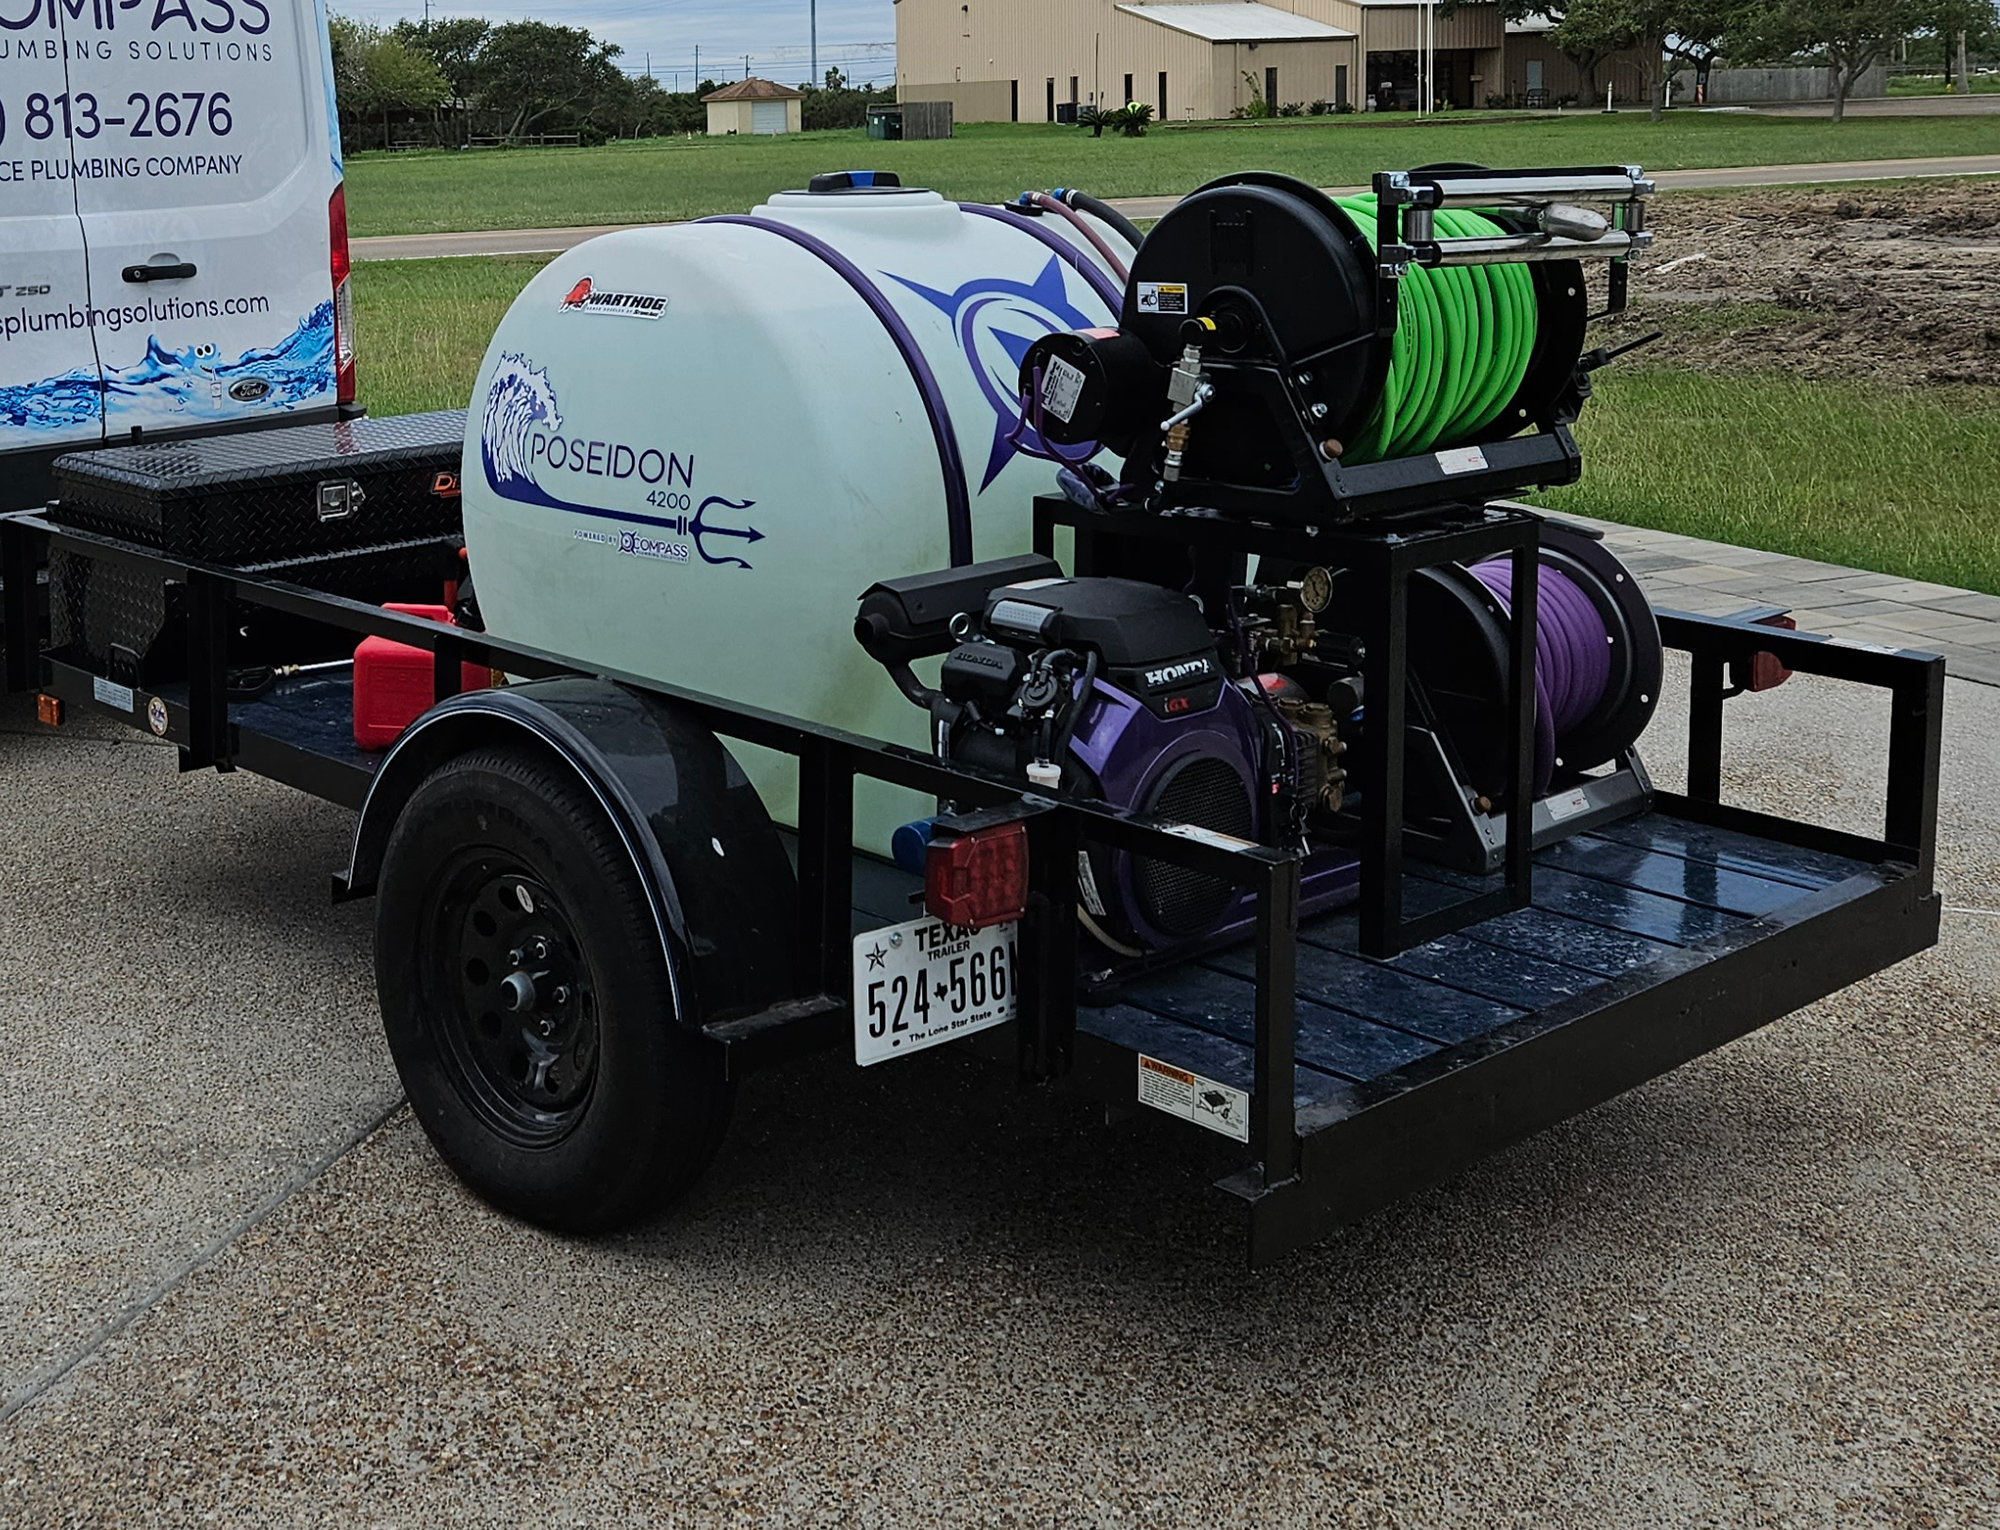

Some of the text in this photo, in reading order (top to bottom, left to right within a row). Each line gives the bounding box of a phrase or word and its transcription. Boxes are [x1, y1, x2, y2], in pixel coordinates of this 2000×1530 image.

[128, 41, 272, 62] SOLUTIONS
[24, 92, 233, 140] 813-2676
[31, 157, 141, 181] PLUMBING
[146, 154, 243, 177] COMPANY
[15, 284, 51, 297] 250
[589, 292, 667, 311] WARTHOG
[240, 383, 264, 398] Ford
[530, 433, 694, 488] POSEIDON
[646, 490, 691, 511] 4200
[574, 529, 618, 544] POWERED BY
[634, 537, 688, 558] COMPASS
[1144, 658, 1216, 688] HONDA
[927, 940, 971, 961] TRAILER
[868, 968, 930, 1039] 524
[908, 1011, 993, 1043] The Lone Star State
